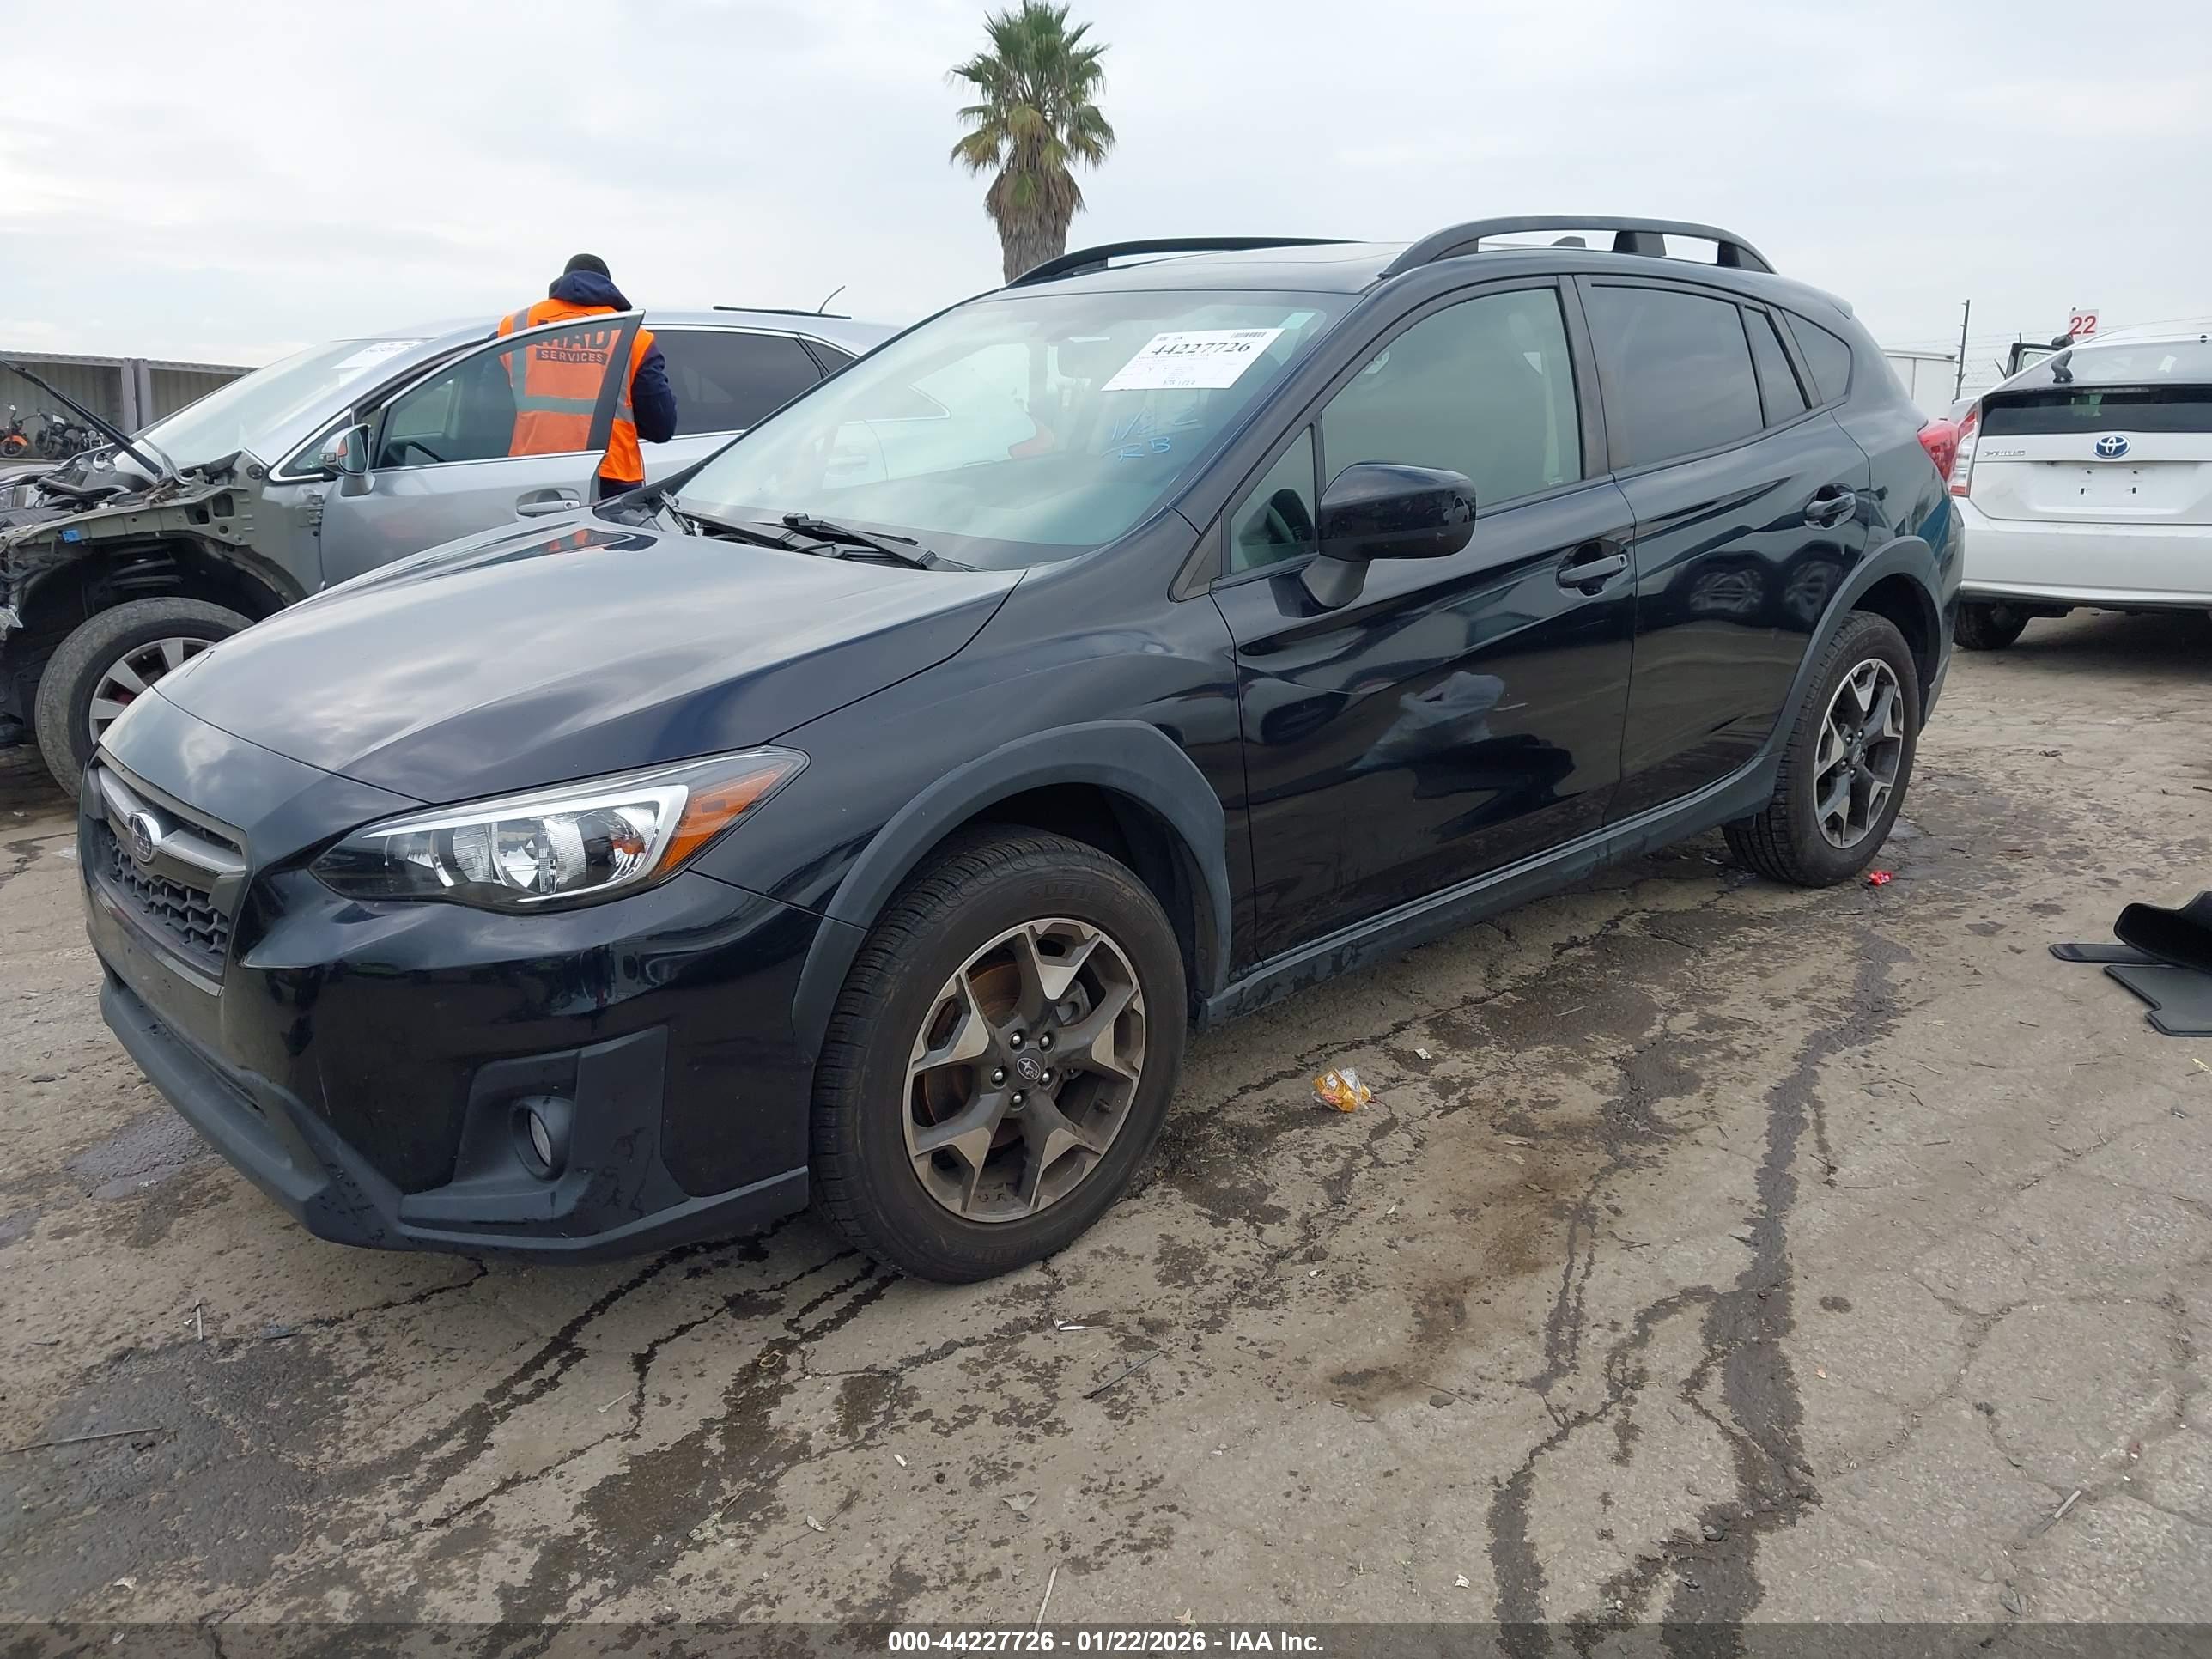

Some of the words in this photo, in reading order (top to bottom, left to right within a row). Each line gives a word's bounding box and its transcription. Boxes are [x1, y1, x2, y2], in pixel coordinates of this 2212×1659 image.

[2069, 315, 2097, 335] 22
[540, 349, 604, 362] SERVICES
[1152, 342, 1254, 356] 44227726
